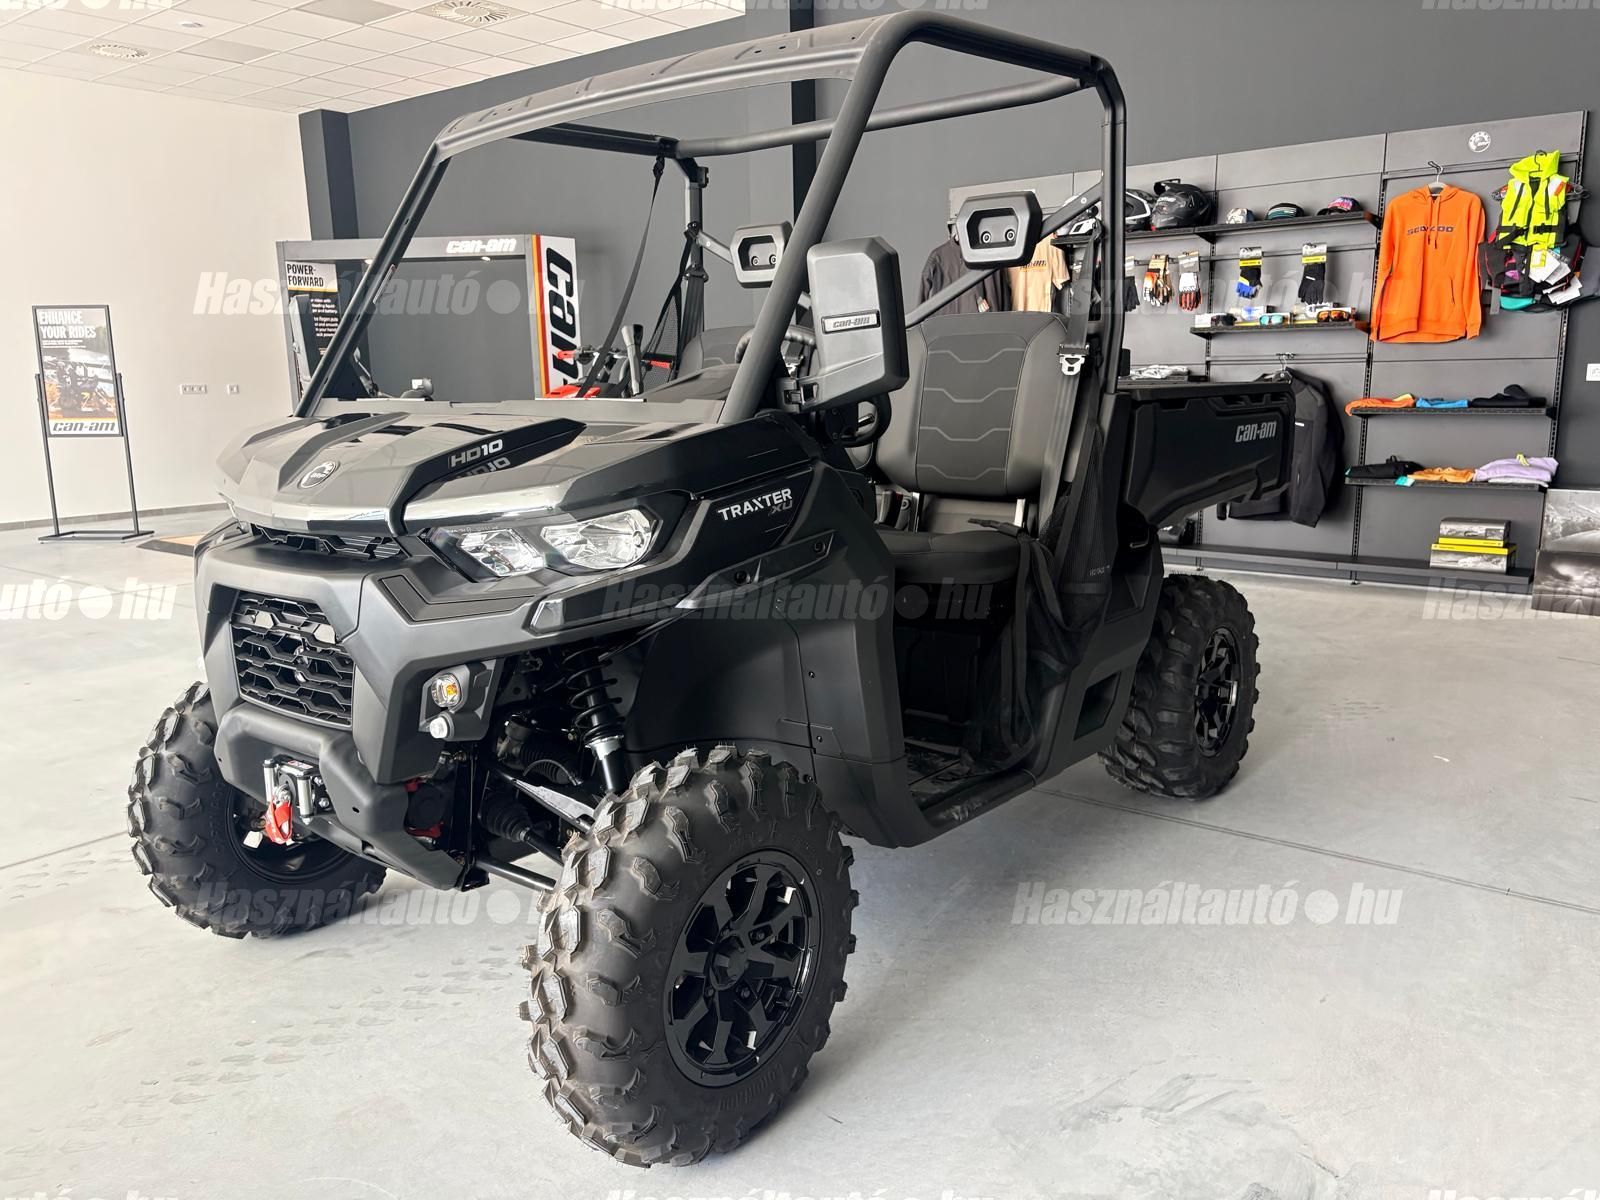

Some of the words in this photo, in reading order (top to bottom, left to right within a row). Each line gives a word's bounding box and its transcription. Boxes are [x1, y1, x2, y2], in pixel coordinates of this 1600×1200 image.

[446, 238, 517, 254] can-am
[287, 263, 316, 275] POWER-
[288, 275, 324, 287] FORWARD
[39, 310, 84, 325] ENHANCE
[832, 315, 870, 329] can-am
[41, 326, 67, 339] YOUR
[69, 326, 97, 339] RIDES
[52, 422, 116, 432] can-am
[1234, 420, 1277, 443] can-am
[450, 438, 504, 468] HD10
[717, 488, 793, 521] TRAXTER
